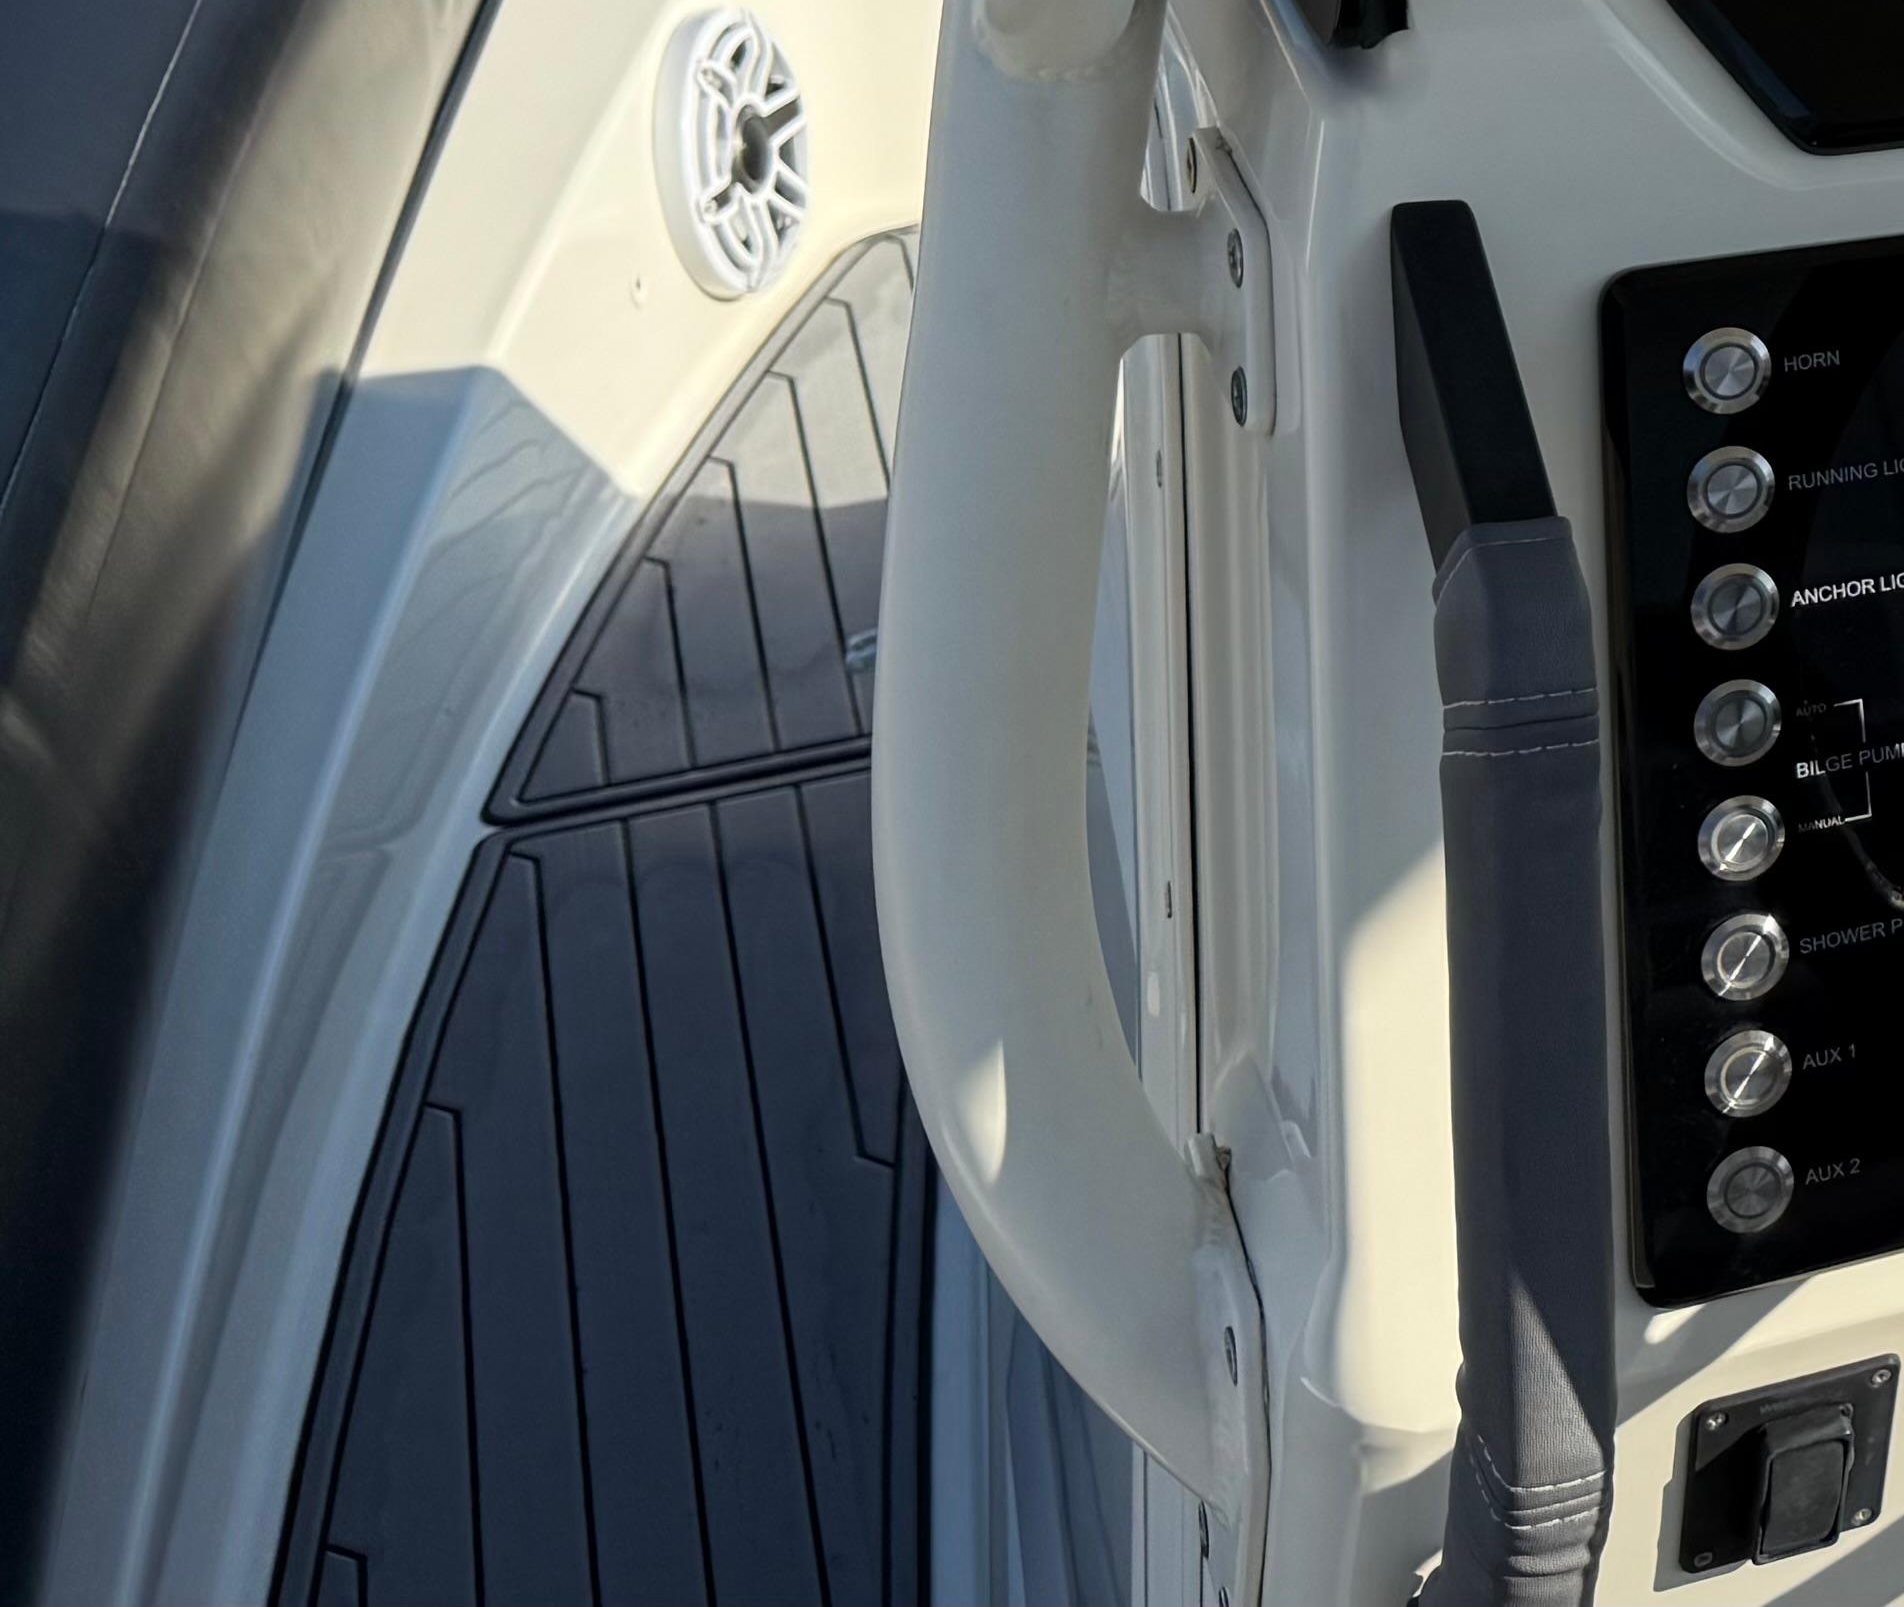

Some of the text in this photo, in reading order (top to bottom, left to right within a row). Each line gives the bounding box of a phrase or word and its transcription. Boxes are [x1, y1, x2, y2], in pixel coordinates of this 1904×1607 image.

[1783, 350, 1841, 373] HORN
[1788, 461, 1878, 491] RUNNING
[1790, 576, 1876, 609] ANCHOR
[1795, 701, 1828, 718] AUTO
[1795, 752, 1854, 779] BILGE
[1797, 814, 1845, 834] MANUAL
[1800, 923, 1887, 955] SHOWER
[1802, 1044, 1858, 1071] AUX 1
[1805, 1157, 1862, 1185] AUX 2
